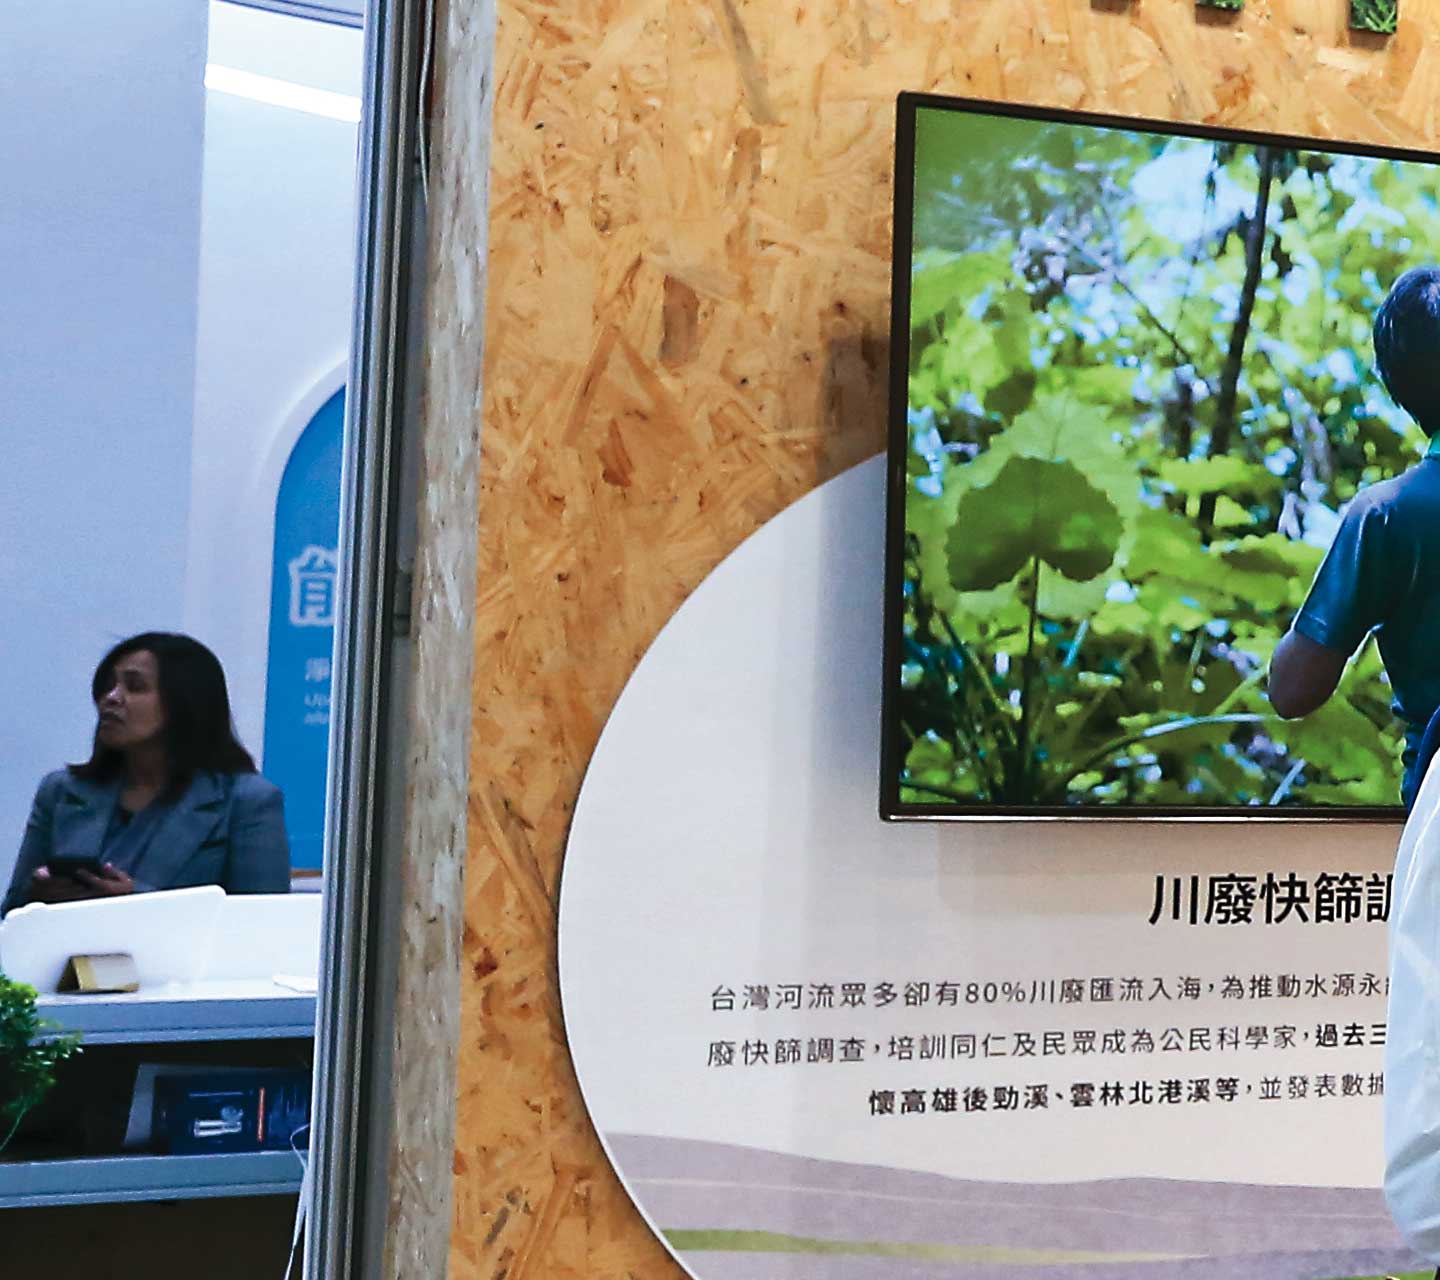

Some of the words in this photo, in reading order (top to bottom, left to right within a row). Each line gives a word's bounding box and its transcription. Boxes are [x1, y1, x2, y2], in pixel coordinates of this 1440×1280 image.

[710, 972, 1389, 1011] 台灣河流眾多卻有80%川廢匯流入海，為推動水源永
